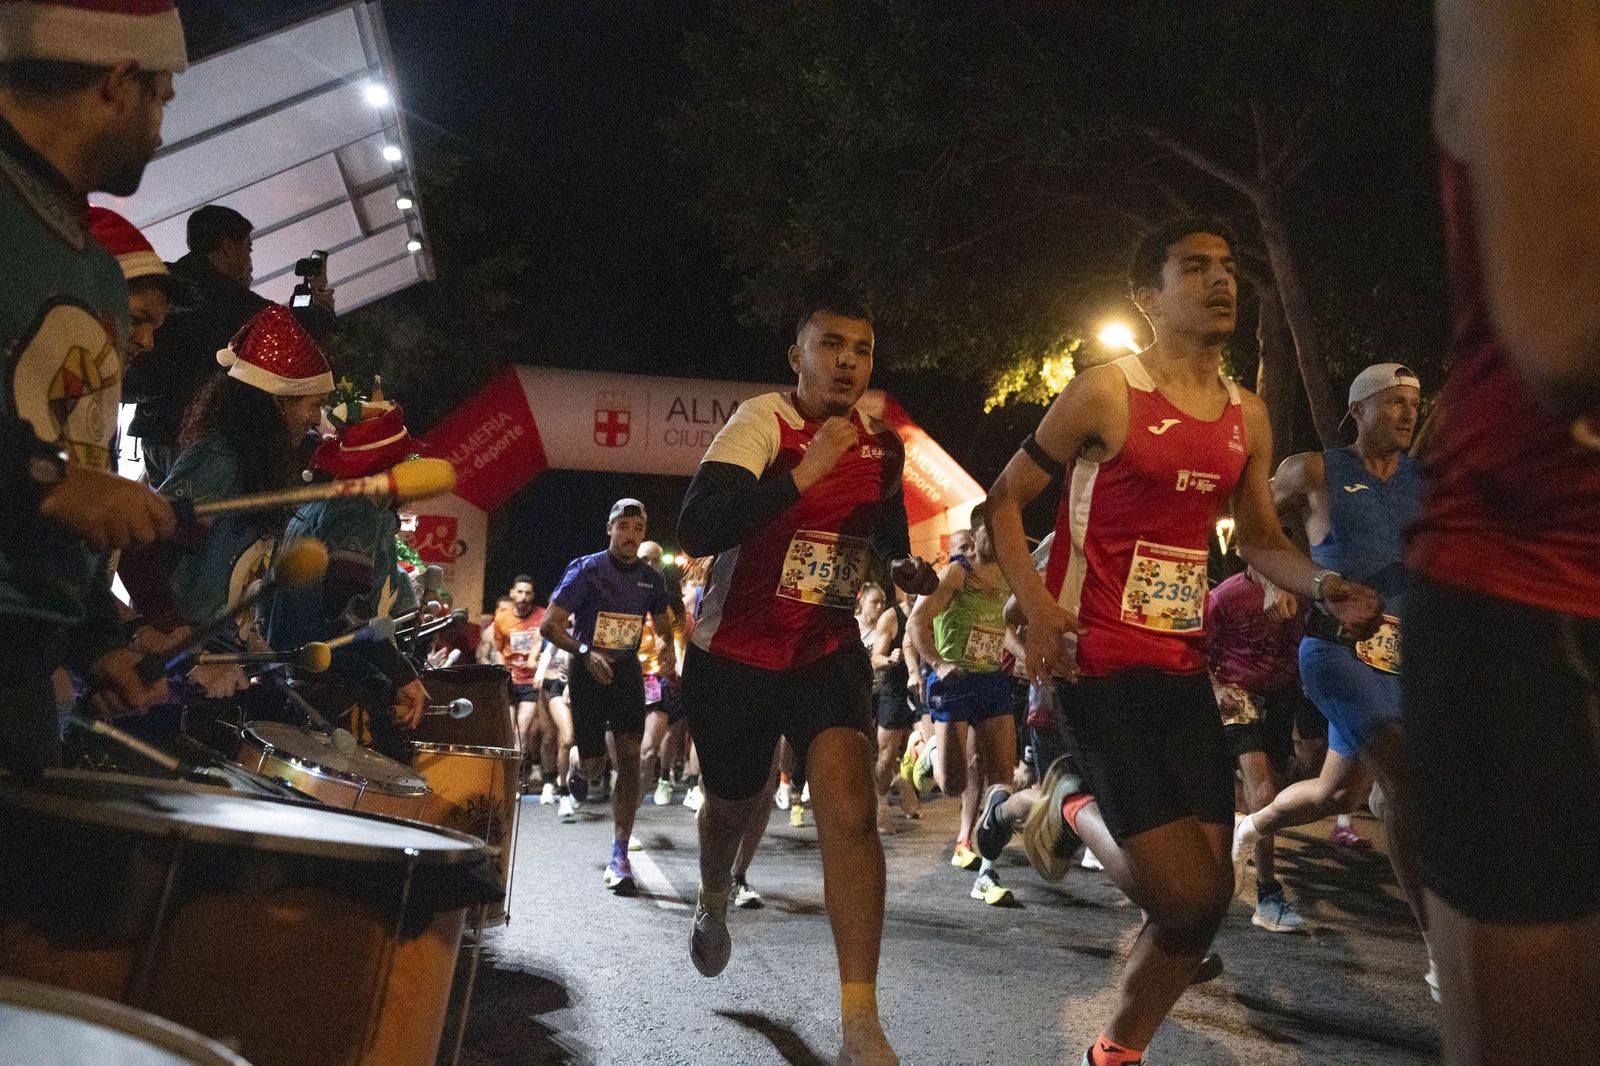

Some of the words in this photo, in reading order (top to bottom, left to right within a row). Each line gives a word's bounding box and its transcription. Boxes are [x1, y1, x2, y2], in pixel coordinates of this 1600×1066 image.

[473, 424, 524, 469] deporte
[807, 560, 851, 581] 1519
[609, 627, 629, 637] 618
